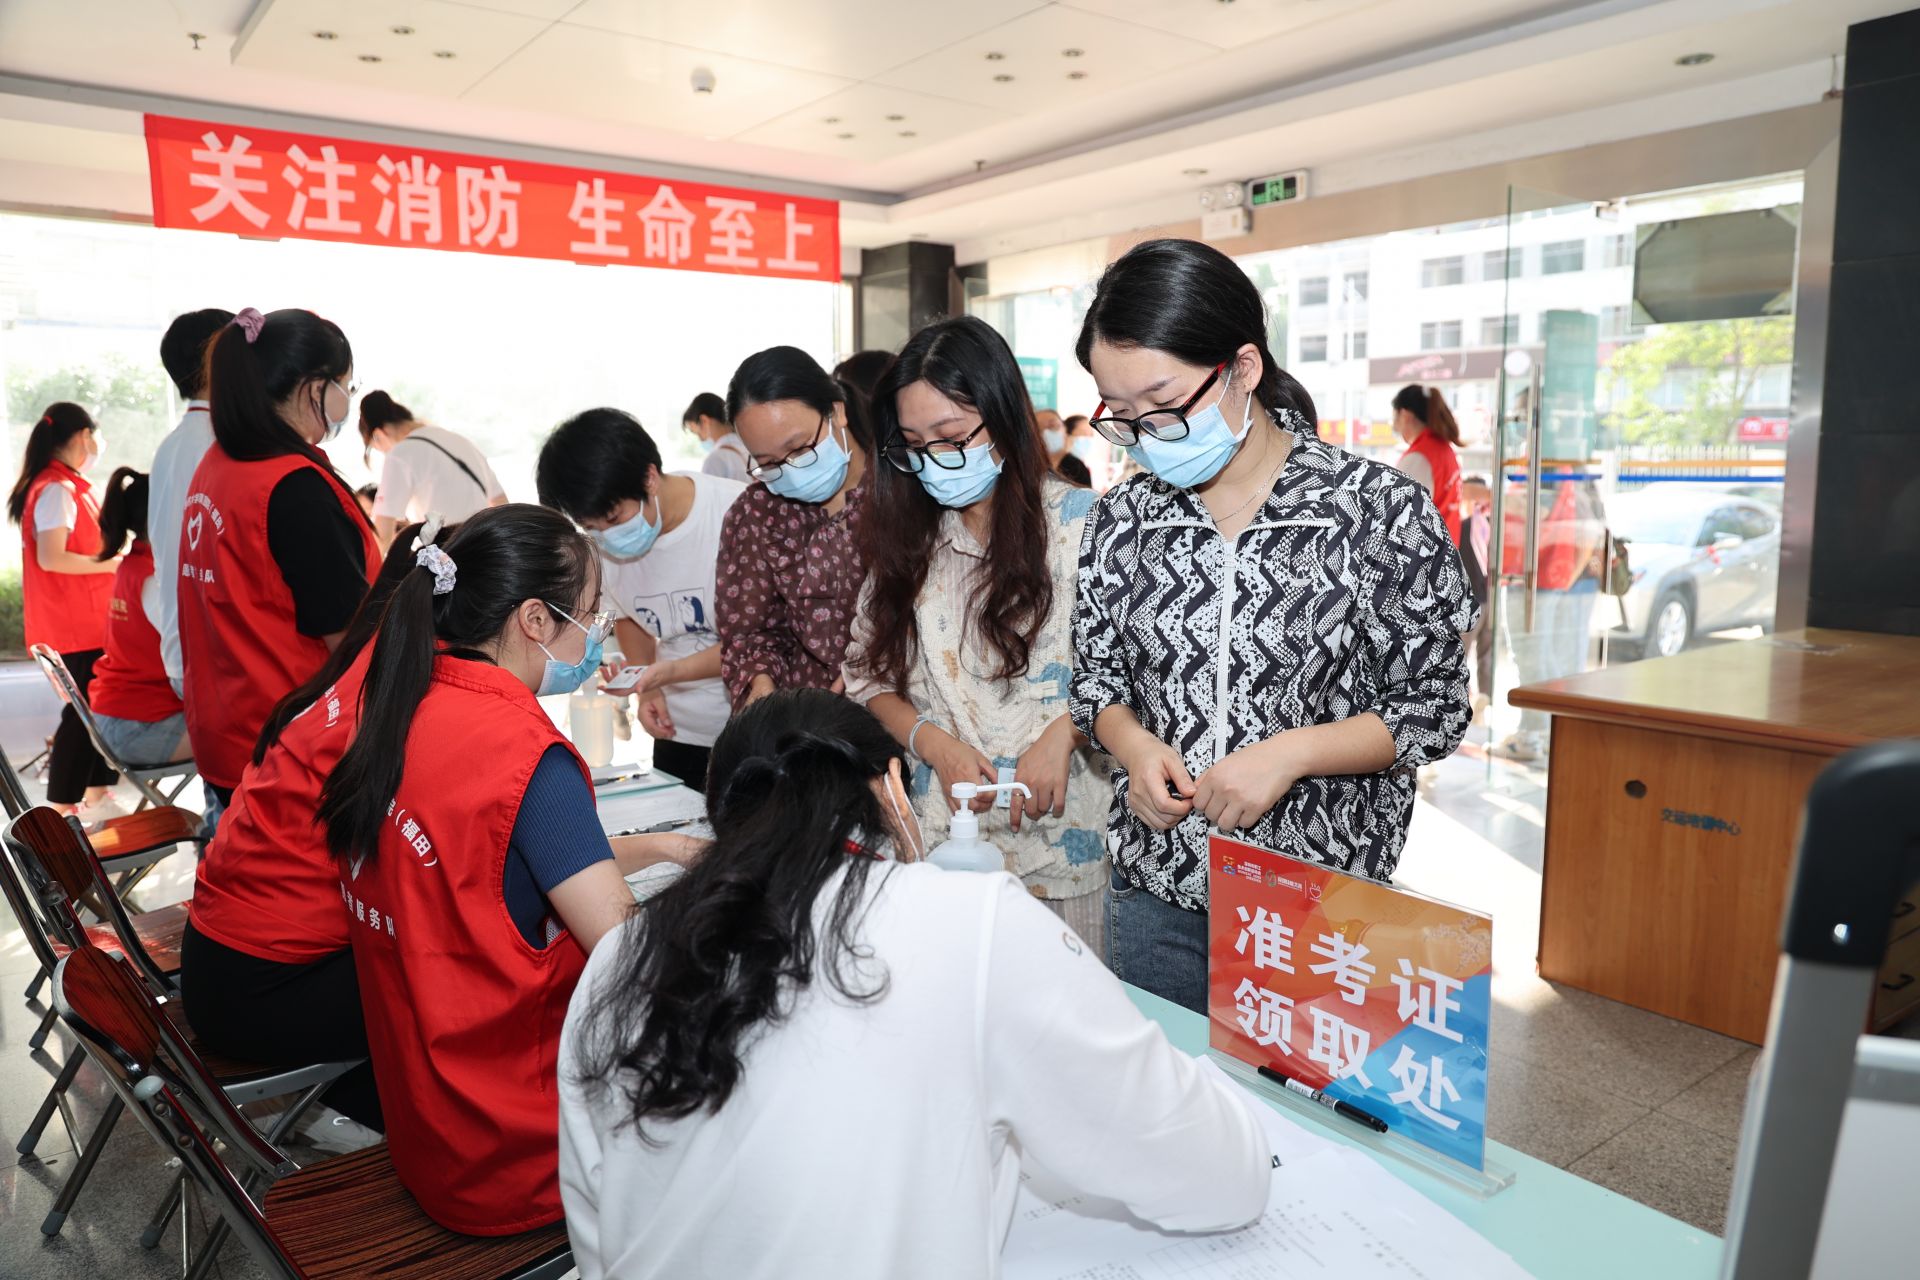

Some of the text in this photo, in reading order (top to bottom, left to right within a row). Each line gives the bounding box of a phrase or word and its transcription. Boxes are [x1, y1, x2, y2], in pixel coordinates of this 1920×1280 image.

[190, 131, 820, 272] 关注消防 生命至上
[1234, 905, 1464, 1043] 准考证
[1233, 977, 1461, 1131] 领取处
